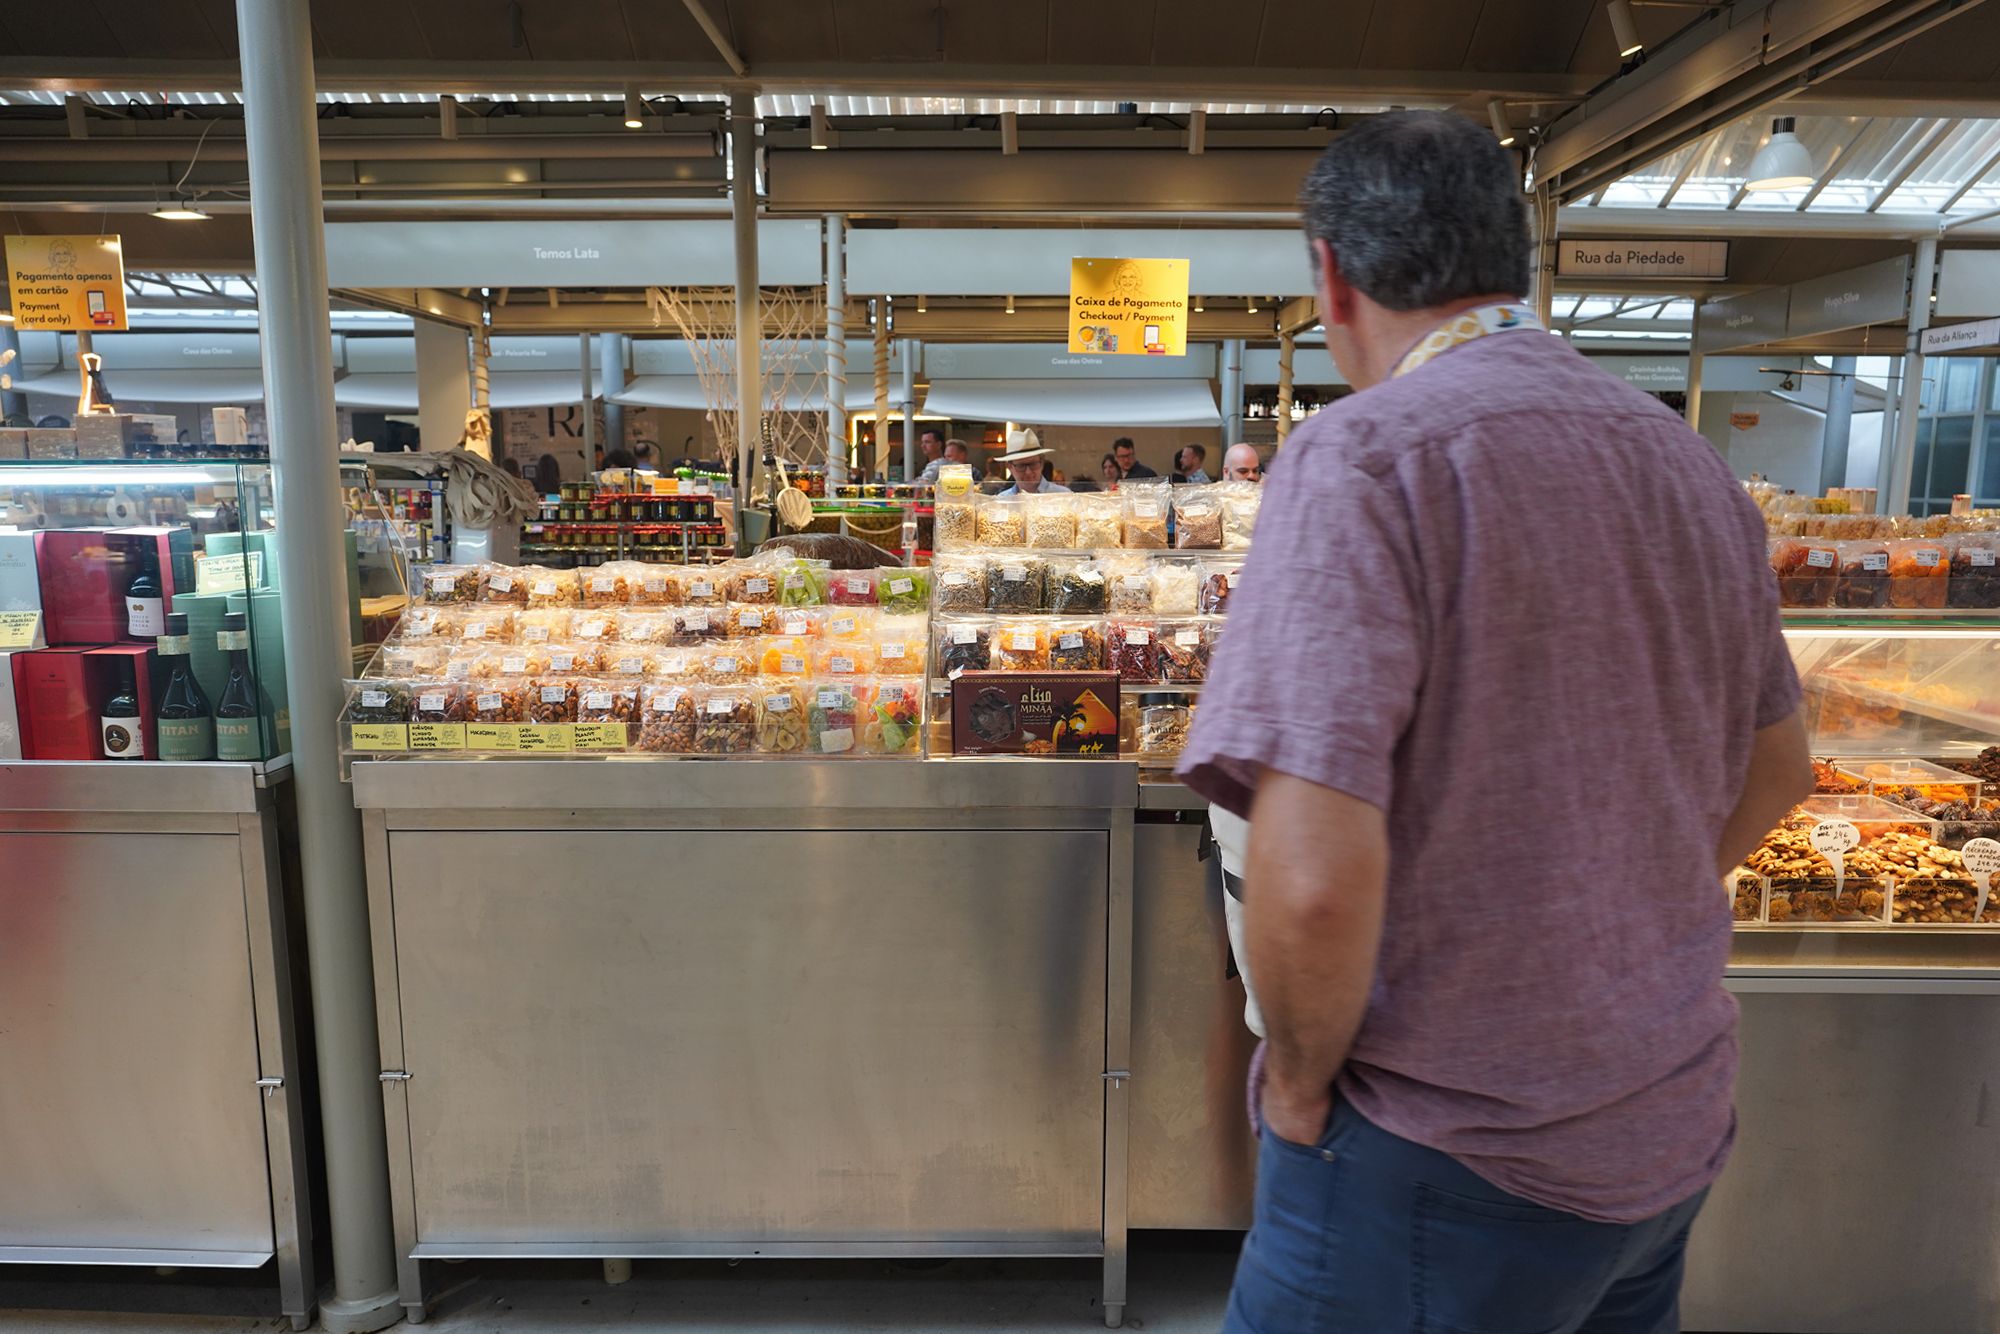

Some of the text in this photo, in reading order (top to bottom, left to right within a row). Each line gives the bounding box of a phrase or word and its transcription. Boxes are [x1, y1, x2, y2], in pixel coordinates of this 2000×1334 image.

[533, 247, 600, 260] Temos Lata
[1575, 250, 1685, 265] Rua da Piedade
[16, 271, 113, 283] Pagamento apenas
[18, 285, 69, 295] em cartão
[19, 301, 60, 312] Payment
[1075, 296, 1183, 309] Caixa de Pagamento
[21, 314, 71, 325] (card only)
[1079, 310, 1123, 321] Checkout
[1133, 312, 1175, 323] Payment
[1927, 330, 1977, 345] Rua da Aliança
[161, 725, 200, 736] TITAN
[216, 724, 249, 735] TITAN
[1148, 726, 1185, 734] Ananas
